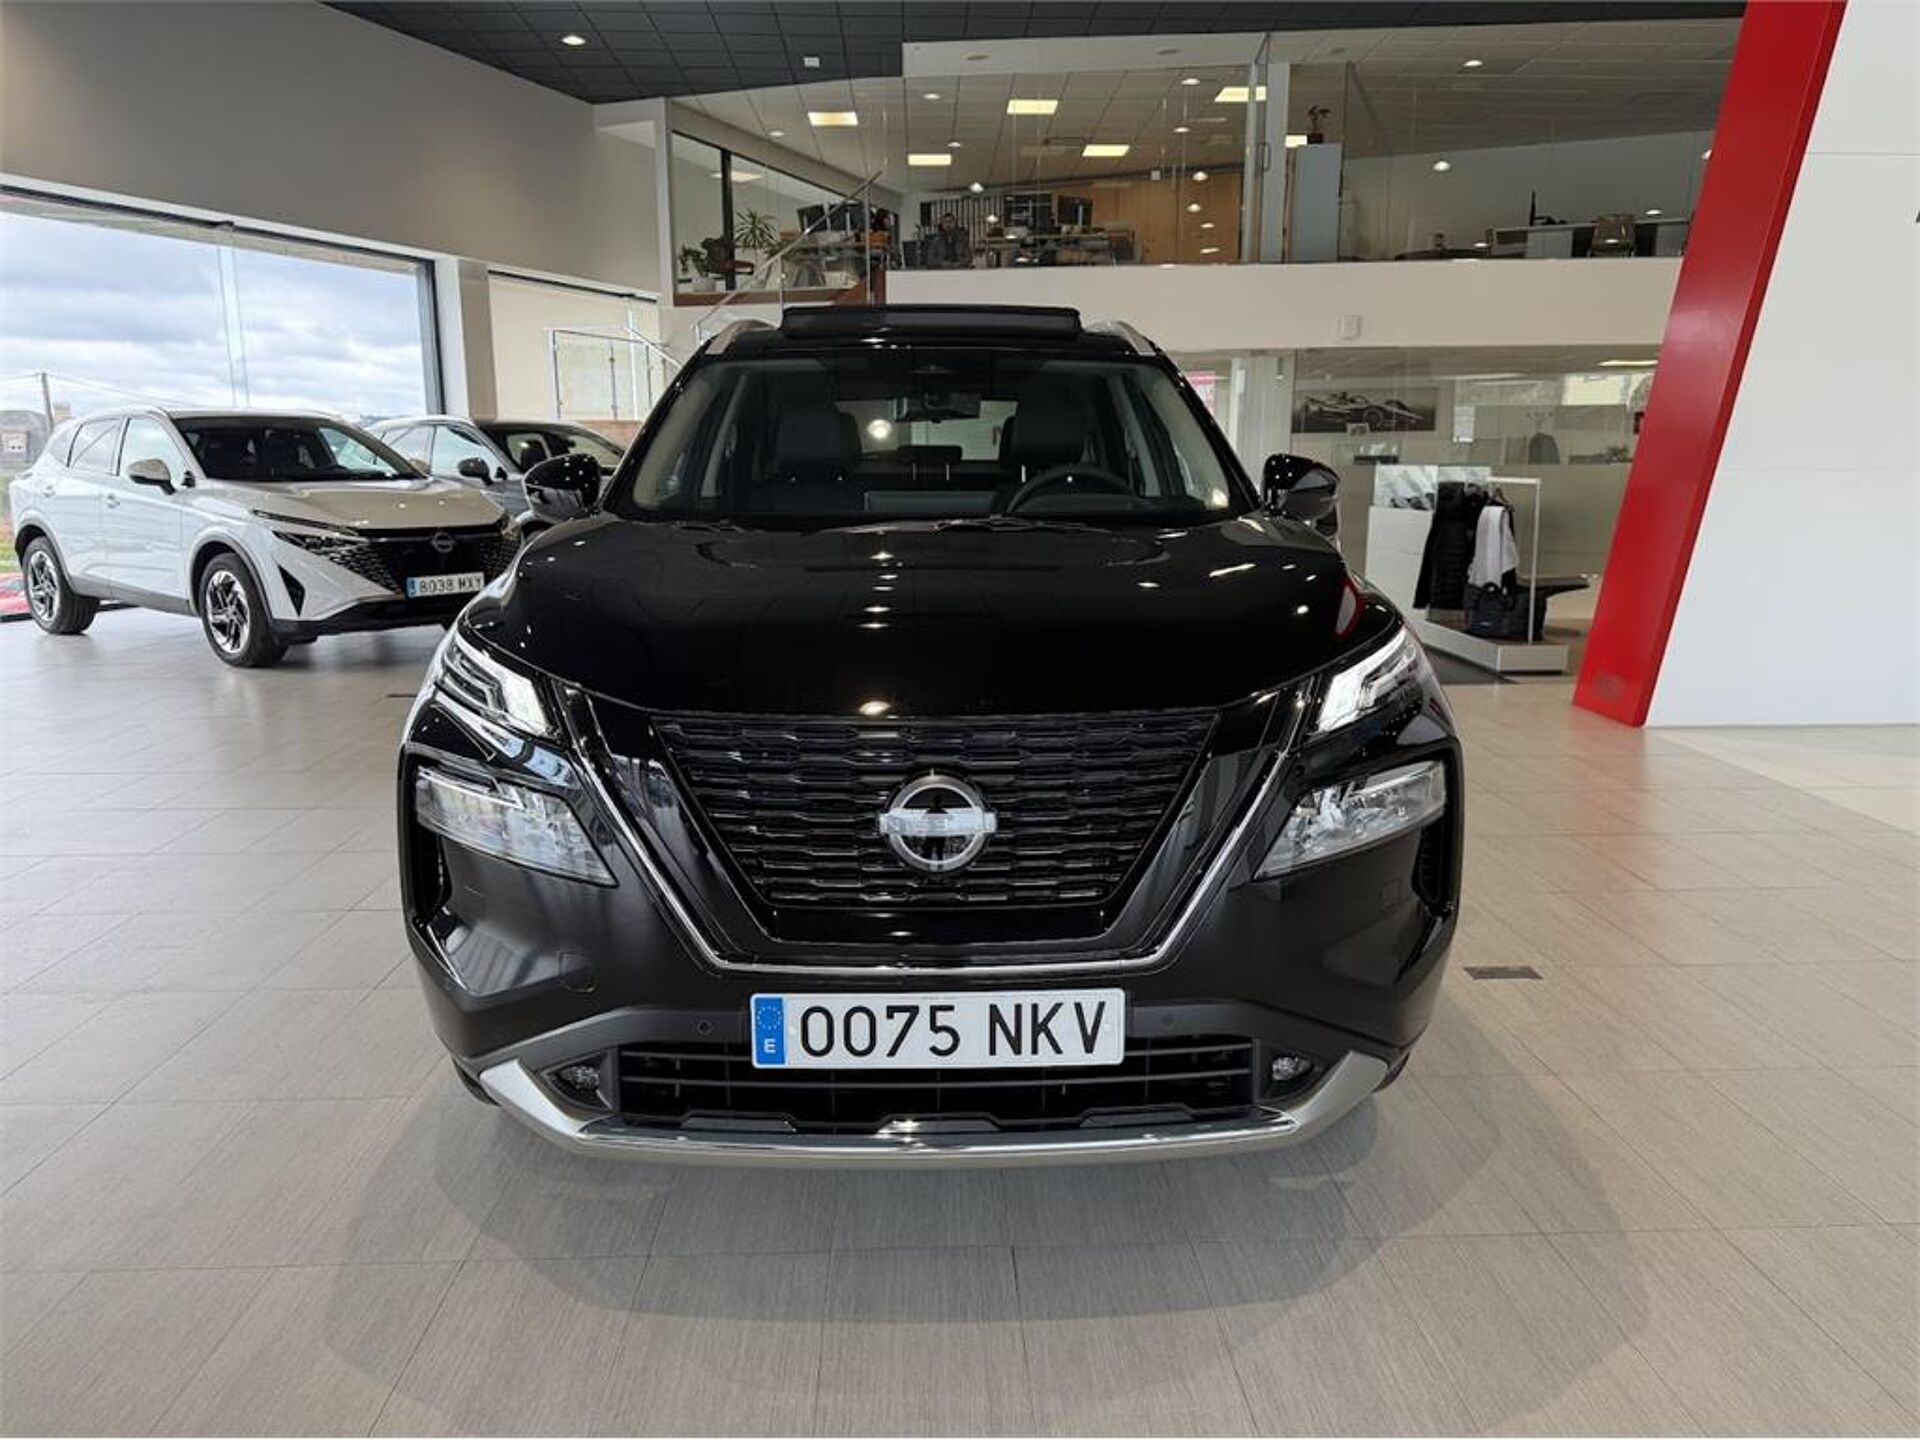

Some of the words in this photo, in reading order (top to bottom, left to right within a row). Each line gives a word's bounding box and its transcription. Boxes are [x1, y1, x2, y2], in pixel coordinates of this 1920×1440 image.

[420, 578, 454, 593] 8038
[801, 1005, 961, 1058] 0075
[988, 1001, 1106, 1056] NKV
[764, 1038, 777, 1054] E
